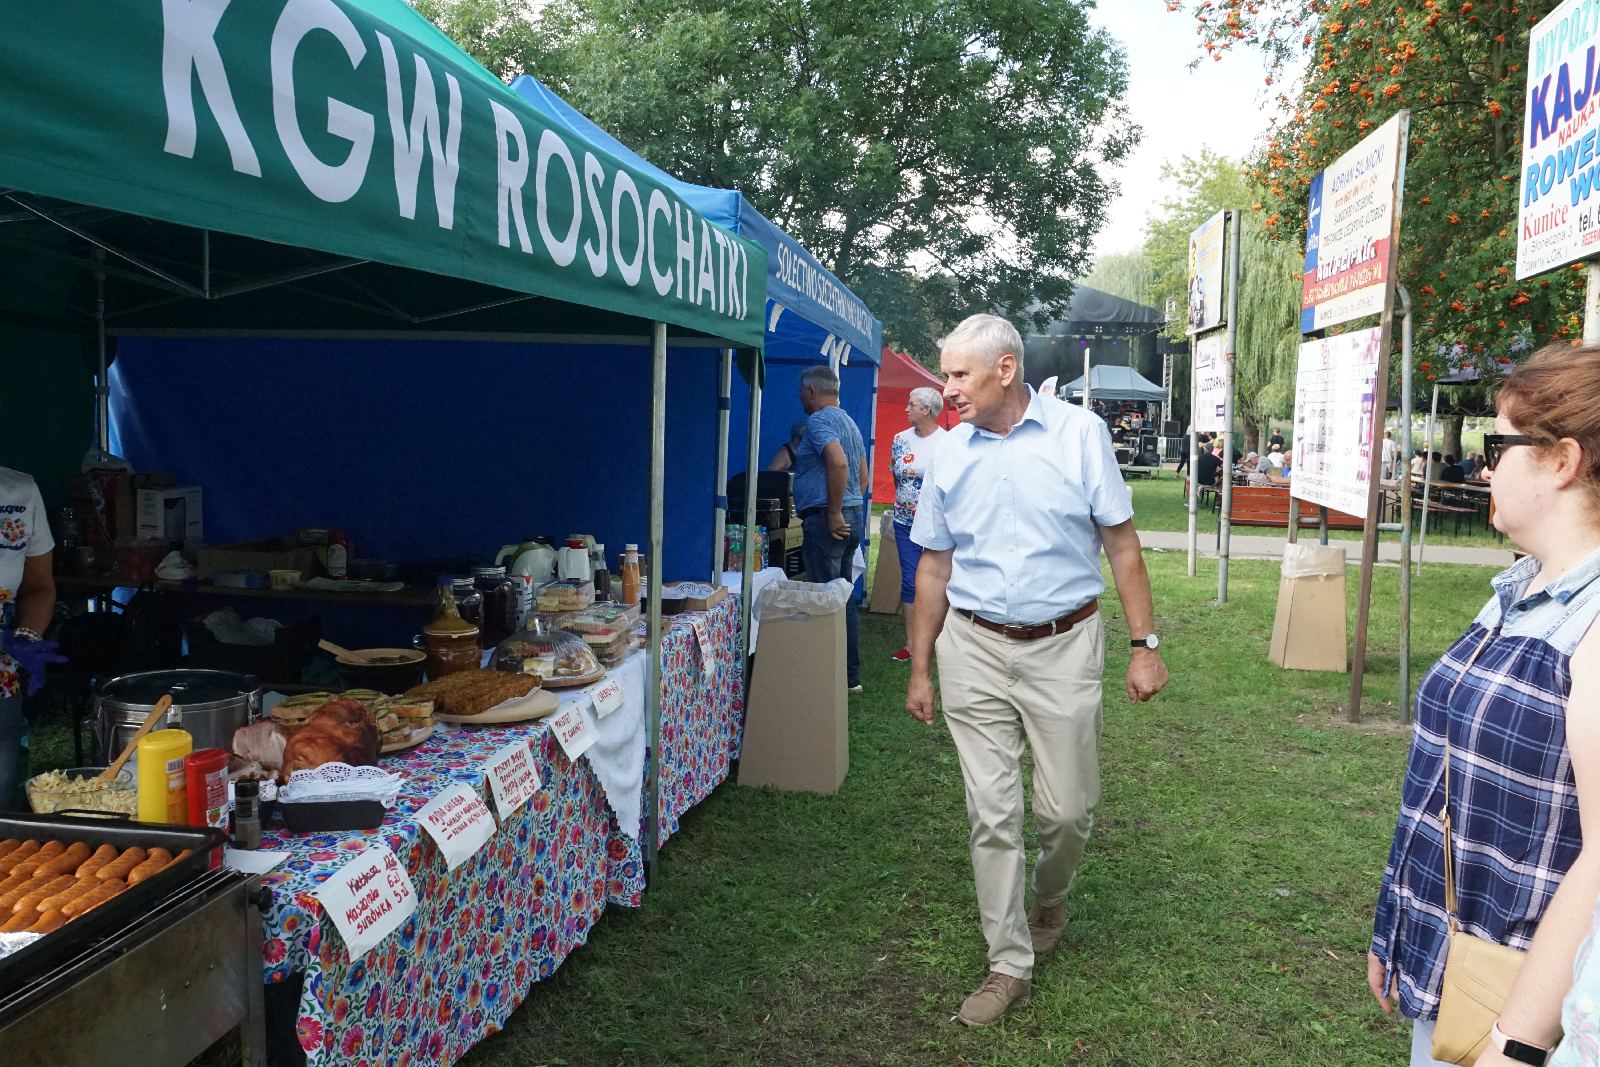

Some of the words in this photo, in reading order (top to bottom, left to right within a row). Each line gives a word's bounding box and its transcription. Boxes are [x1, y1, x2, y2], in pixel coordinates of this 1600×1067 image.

[162, 0, 464, 230] KGW
[488, 98, 748, 320] ROSOCHATKI
[1524, 128, 1600, 208] ROWE
[1523, 203, 1569, 241] Kunice
[1579, 206, 1594, 233] tel.
[356, 898, 393, 935] SURÓWKA
